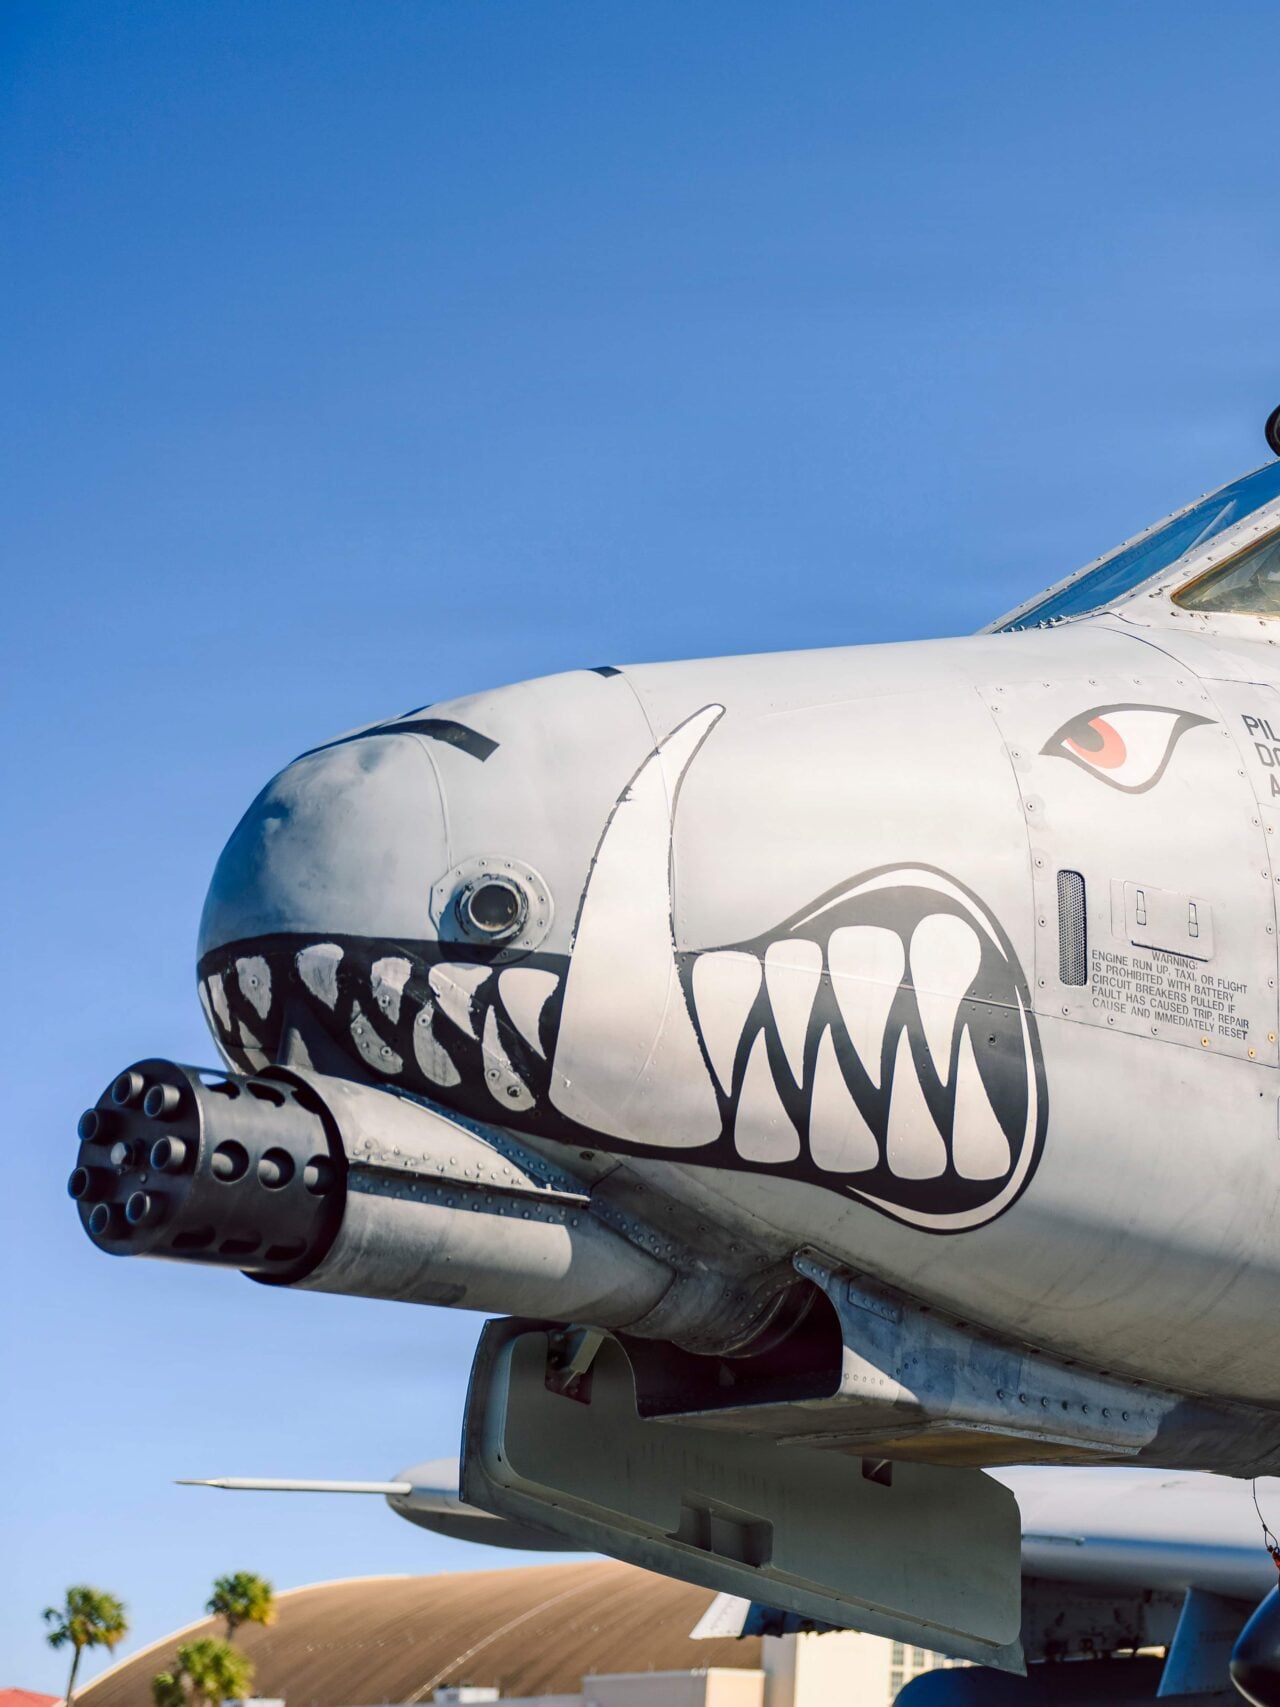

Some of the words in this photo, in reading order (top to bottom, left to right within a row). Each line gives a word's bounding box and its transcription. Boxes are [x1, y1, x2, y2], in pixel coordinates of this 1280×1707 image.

[1092, 949, 1128, 967] ENGINE
[1132, 959, 1152, 972] RUN
[1201, 974, 1214, 986] OR
[1217, 979, 1248, 994] FLIGHT
[1152, 951, 1198, 969] WARNING:
[1092, 961, 1102, 972] IS
[1106, 964, 1163, 985] PROHIBITED
[1167, 978, 1191, 992] WITH
[1194, 985, 1234, 1002] BATTERY
[1092, 973, 1132, 990] CIRCUIT
[1135, 983, 1187, 1003] BREAKERS
[1191, 995, 1224, 1011] PULLED
[1228, 1004, 1236, 1014] IF
[1091, 985, 1122, 1000] FAULT
[1126, 993, 1146, 1005] HAS
[1150, 998, 1189, 1015] CAUSED
[1218, 1013, 1249, 1029] REPAIR
[1092, 997, 1126, 1014] CAUSE
[1131, 1006, 1150, 1019] AND
[1154, 1010, 1215, 1032] IMMEDIATELY
[1218, 1025, 1248, 1040] RESET
